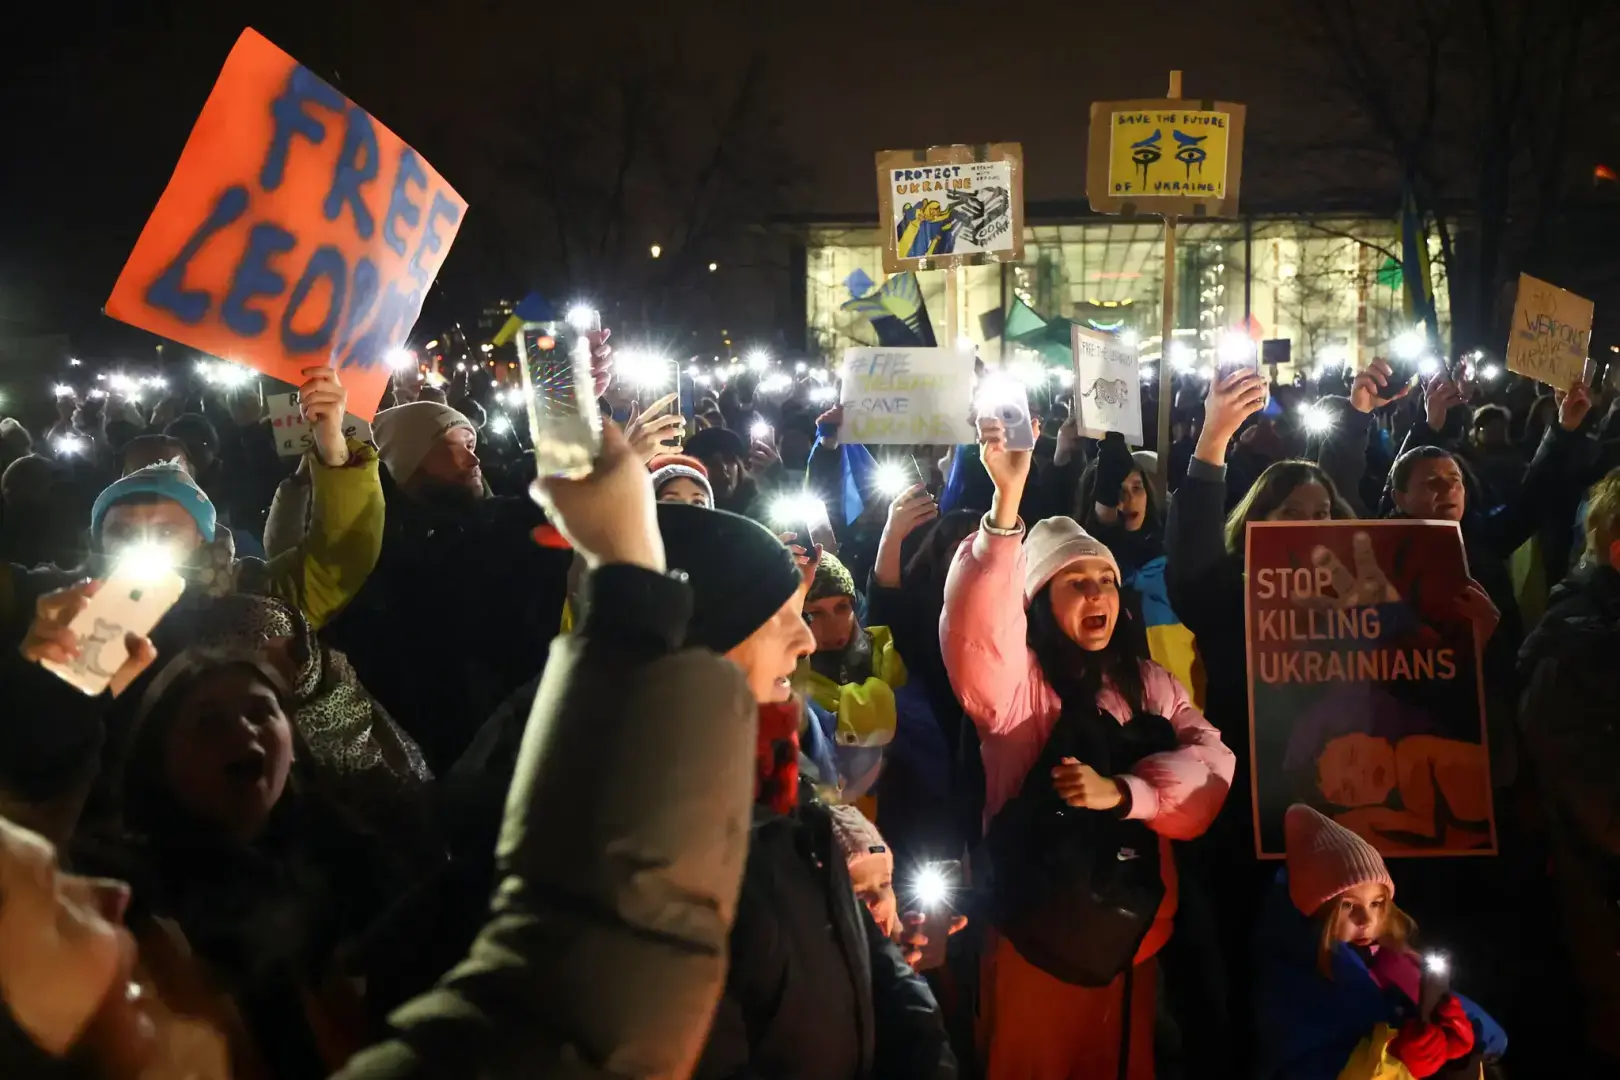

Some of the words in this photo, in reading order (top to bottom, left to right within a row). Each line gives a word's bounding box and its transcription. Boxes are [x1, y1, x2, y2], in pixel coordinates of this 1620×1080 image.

[1118, 114, 1150, 125] SAVE
[1157, 114, 1176, 124] THE
[1183, 115, 1225, 128] FUTURE
[259, 63, 459, 291] FREE
[894, 166, 961, 182] PROTECT
[896, 178, 972, 194] UKRAINE
[1115, 181, 1132, 192] OF
[1257, 567, 1333, 599] STOP
[1258, 608, 1381, 641] KILLING
[1259, 649, 1456, 683] UKRAINIANS
